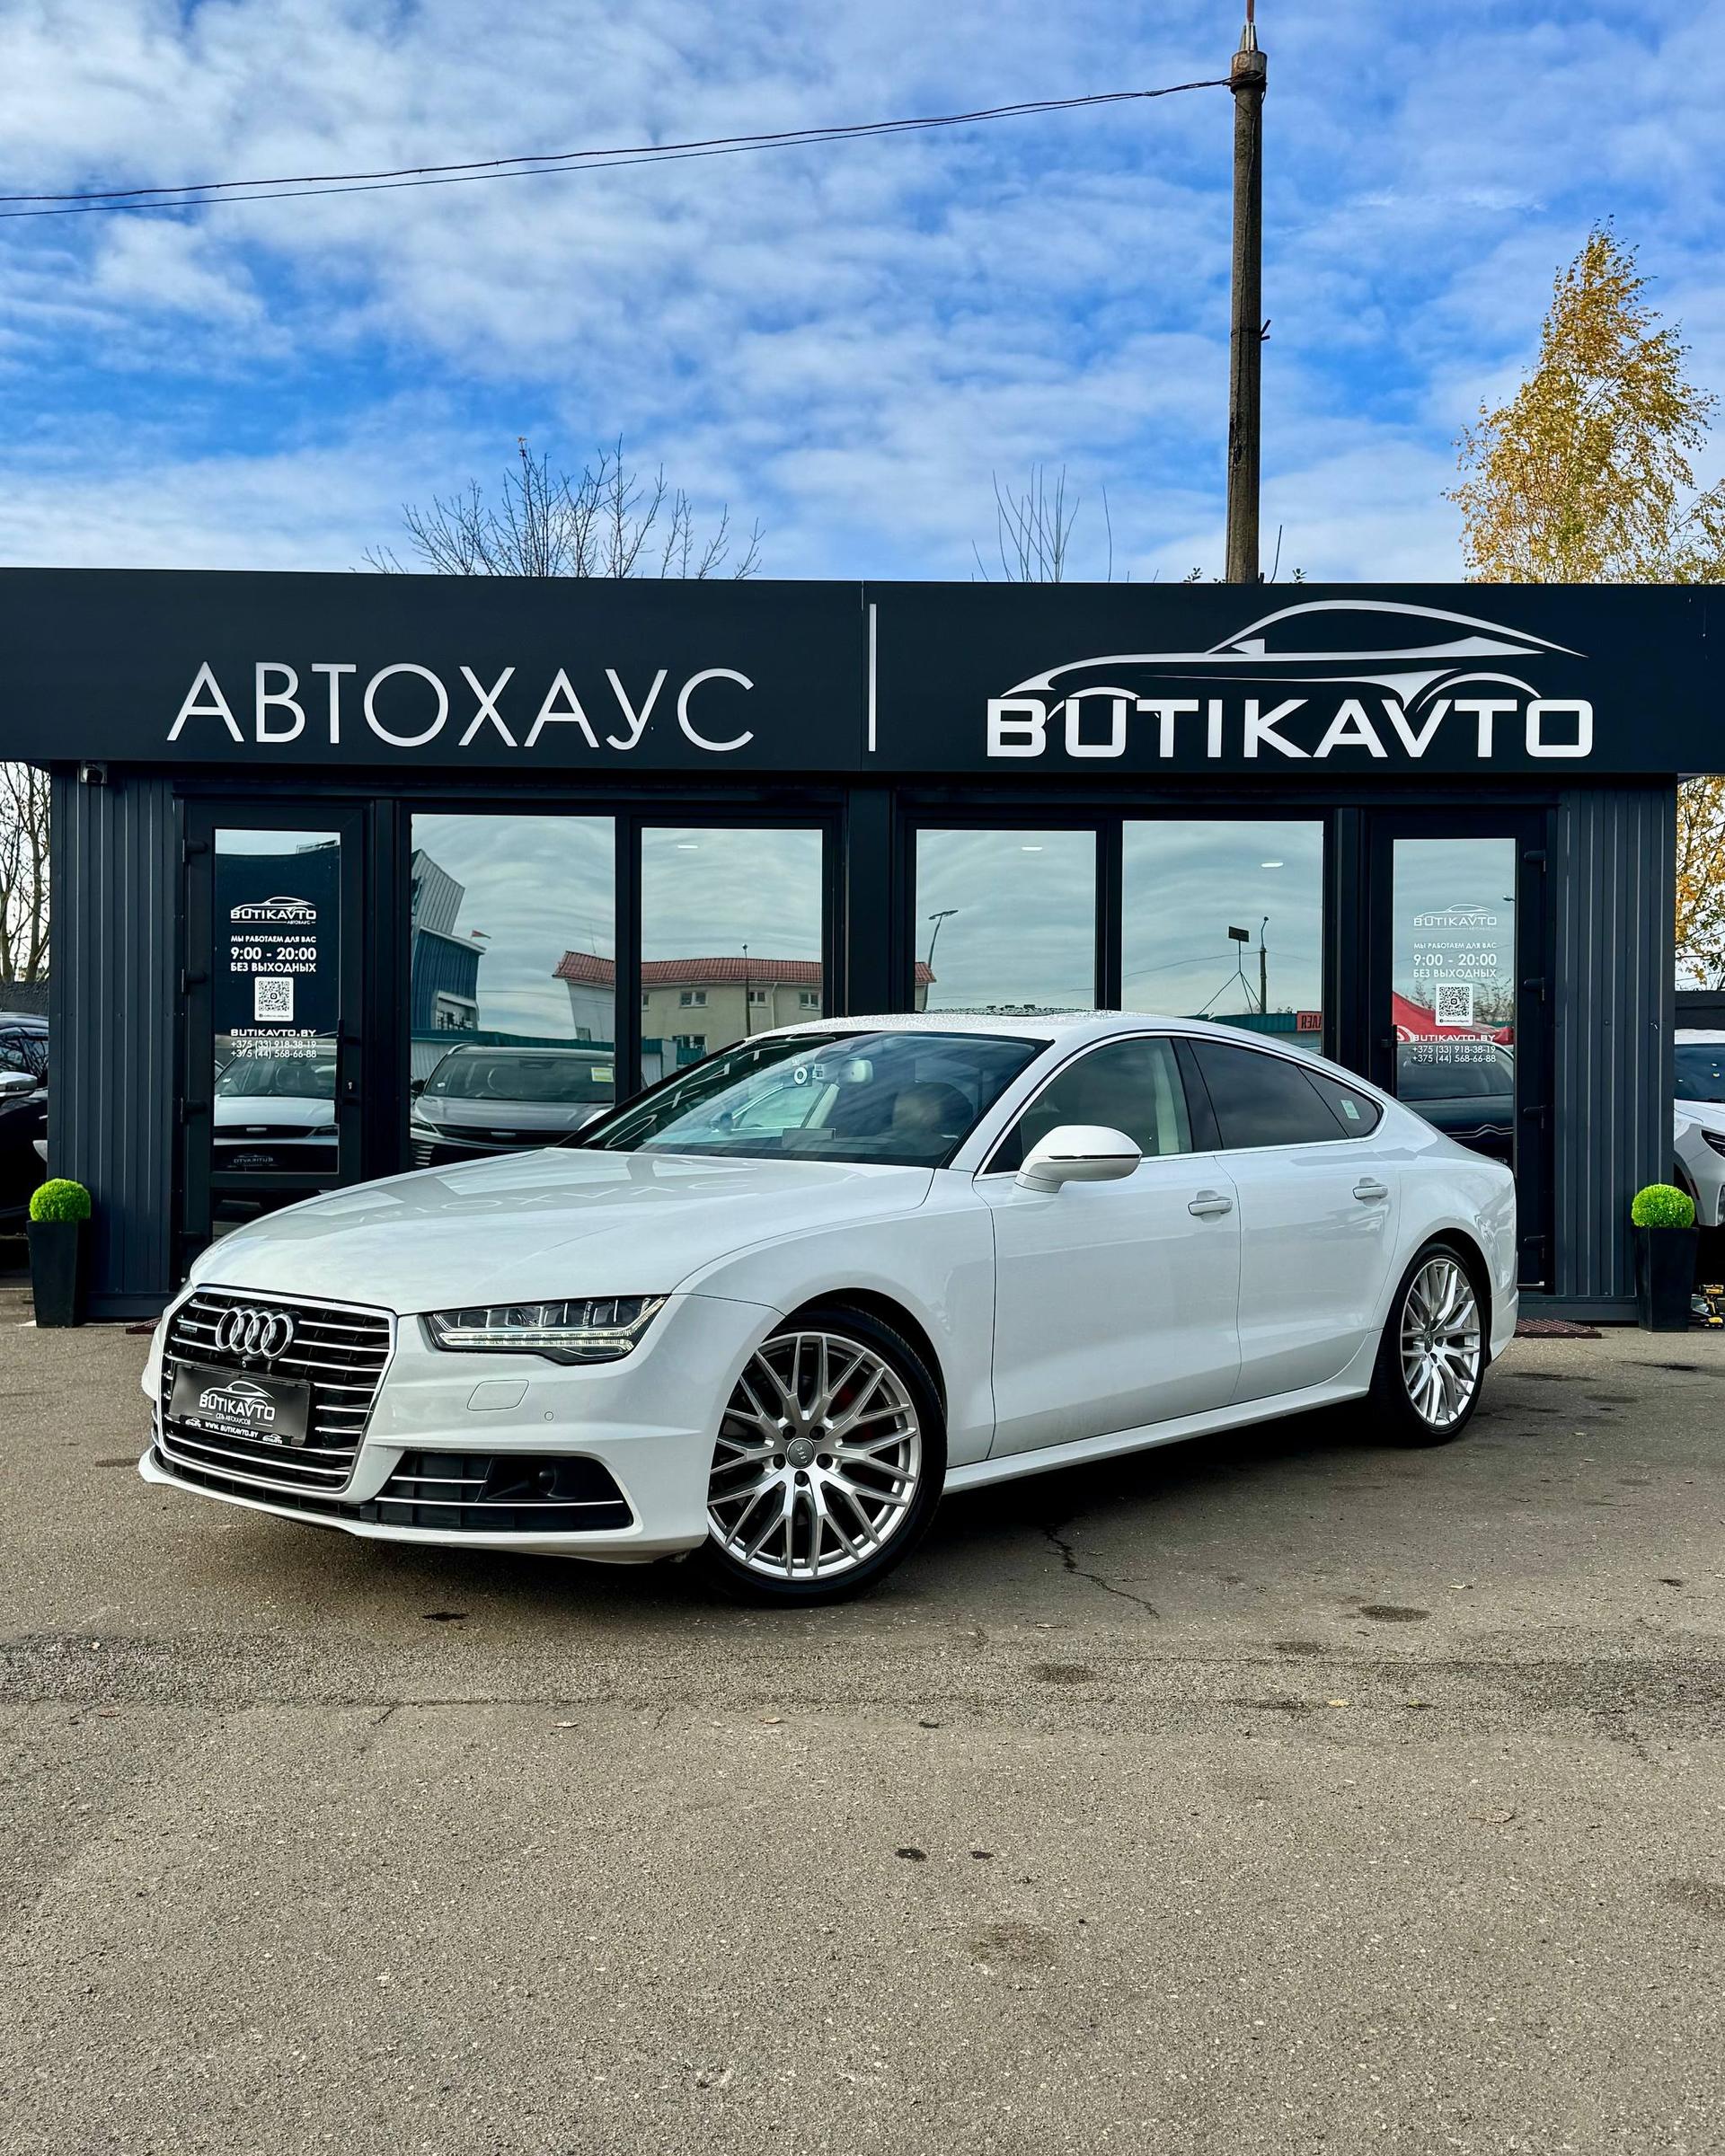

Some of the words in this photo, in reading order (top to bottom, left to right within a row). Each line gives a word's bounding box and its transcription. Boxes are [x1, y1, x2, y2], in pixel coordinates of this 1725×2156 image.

[166, 661, 755, 752] АВТОХАУС
[986, 698, 1594, 758] BUTIKAVTO
[230, 909, 317, 920] BUTIKAVTO
[1413, 916, 1497, 926] BUTIKAVTO
[230, 947, 261, 960] 9:00
[277, 947, 317, 960] 20:00
[1413, 953, 1443, 967] 9:00
[1458, 953, 1497, 967] 20:00
[230, 962, 249, 972] БЕЗ
[252, 962, 316, 973] ВЫХОДНЫХ
[1413, 968, 1430, 978] БЕЗ
[1433, 968, 1497, 979] ВЫХОДНЫХ
[230, 1029, 317, 1037] BUTIKAVTO.BY
[1413, 1034, 1496, 1042] BUTIKAVTO.BY
[231, 1040, 252, 1049] +375
[254, 1039, 271, 1050] (33)
[275, 1040, 317, 1049] 918-38-19
[231, 1050, 252, 1058] +375
[254, 1049, 271, 1060] (44)
[275, 1050, 317, 1058] 568-66-88
[1412, 1045, 1433, 1054] +375
[1436, 1045, 1452, 1056] (33)
[1455, 1045, 1496, 1054] 918-38-19
[1412, 1054, 1433, 1063] +375
[1436, 1054, 1452, 1065] (44)
[1455, 1054, 1496, 1063] 568-66-88
[199, 1393, 275, 1420] BUTIKAVTO
